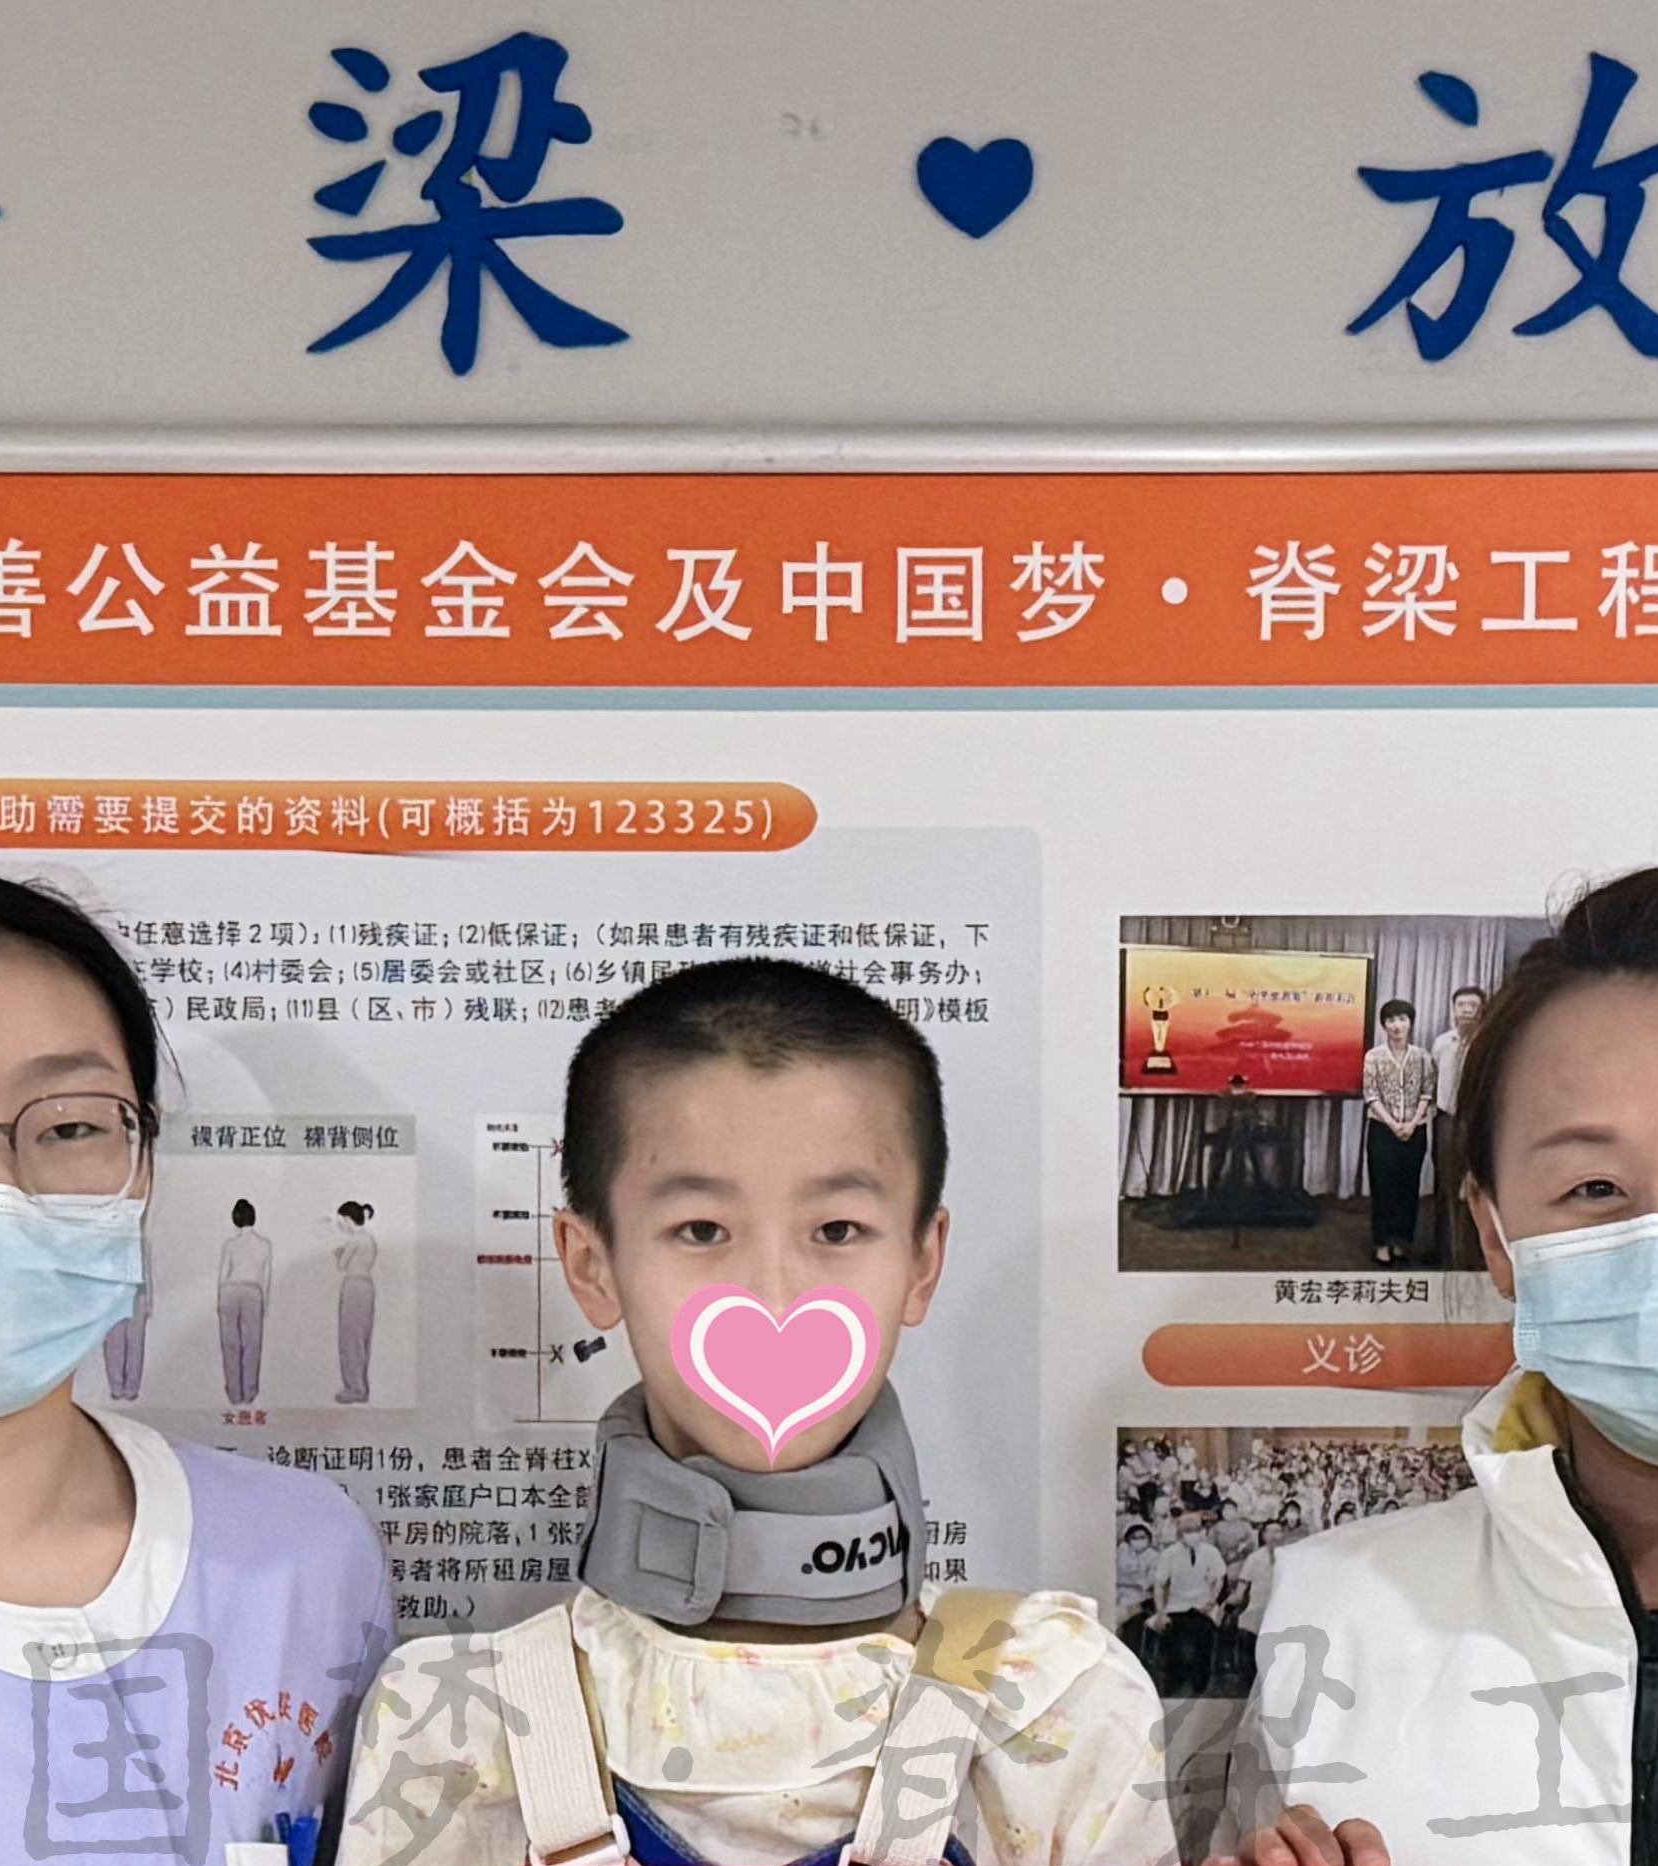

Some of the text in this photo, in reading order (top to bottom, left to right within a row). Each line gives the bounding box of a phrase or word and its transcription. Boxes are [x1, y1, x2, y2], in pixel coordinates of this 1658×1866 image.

[1273, 1278, 1429, 1304] 黄宏李莉夫妇
[1302, 1333, 1385, 1375] 义诊
